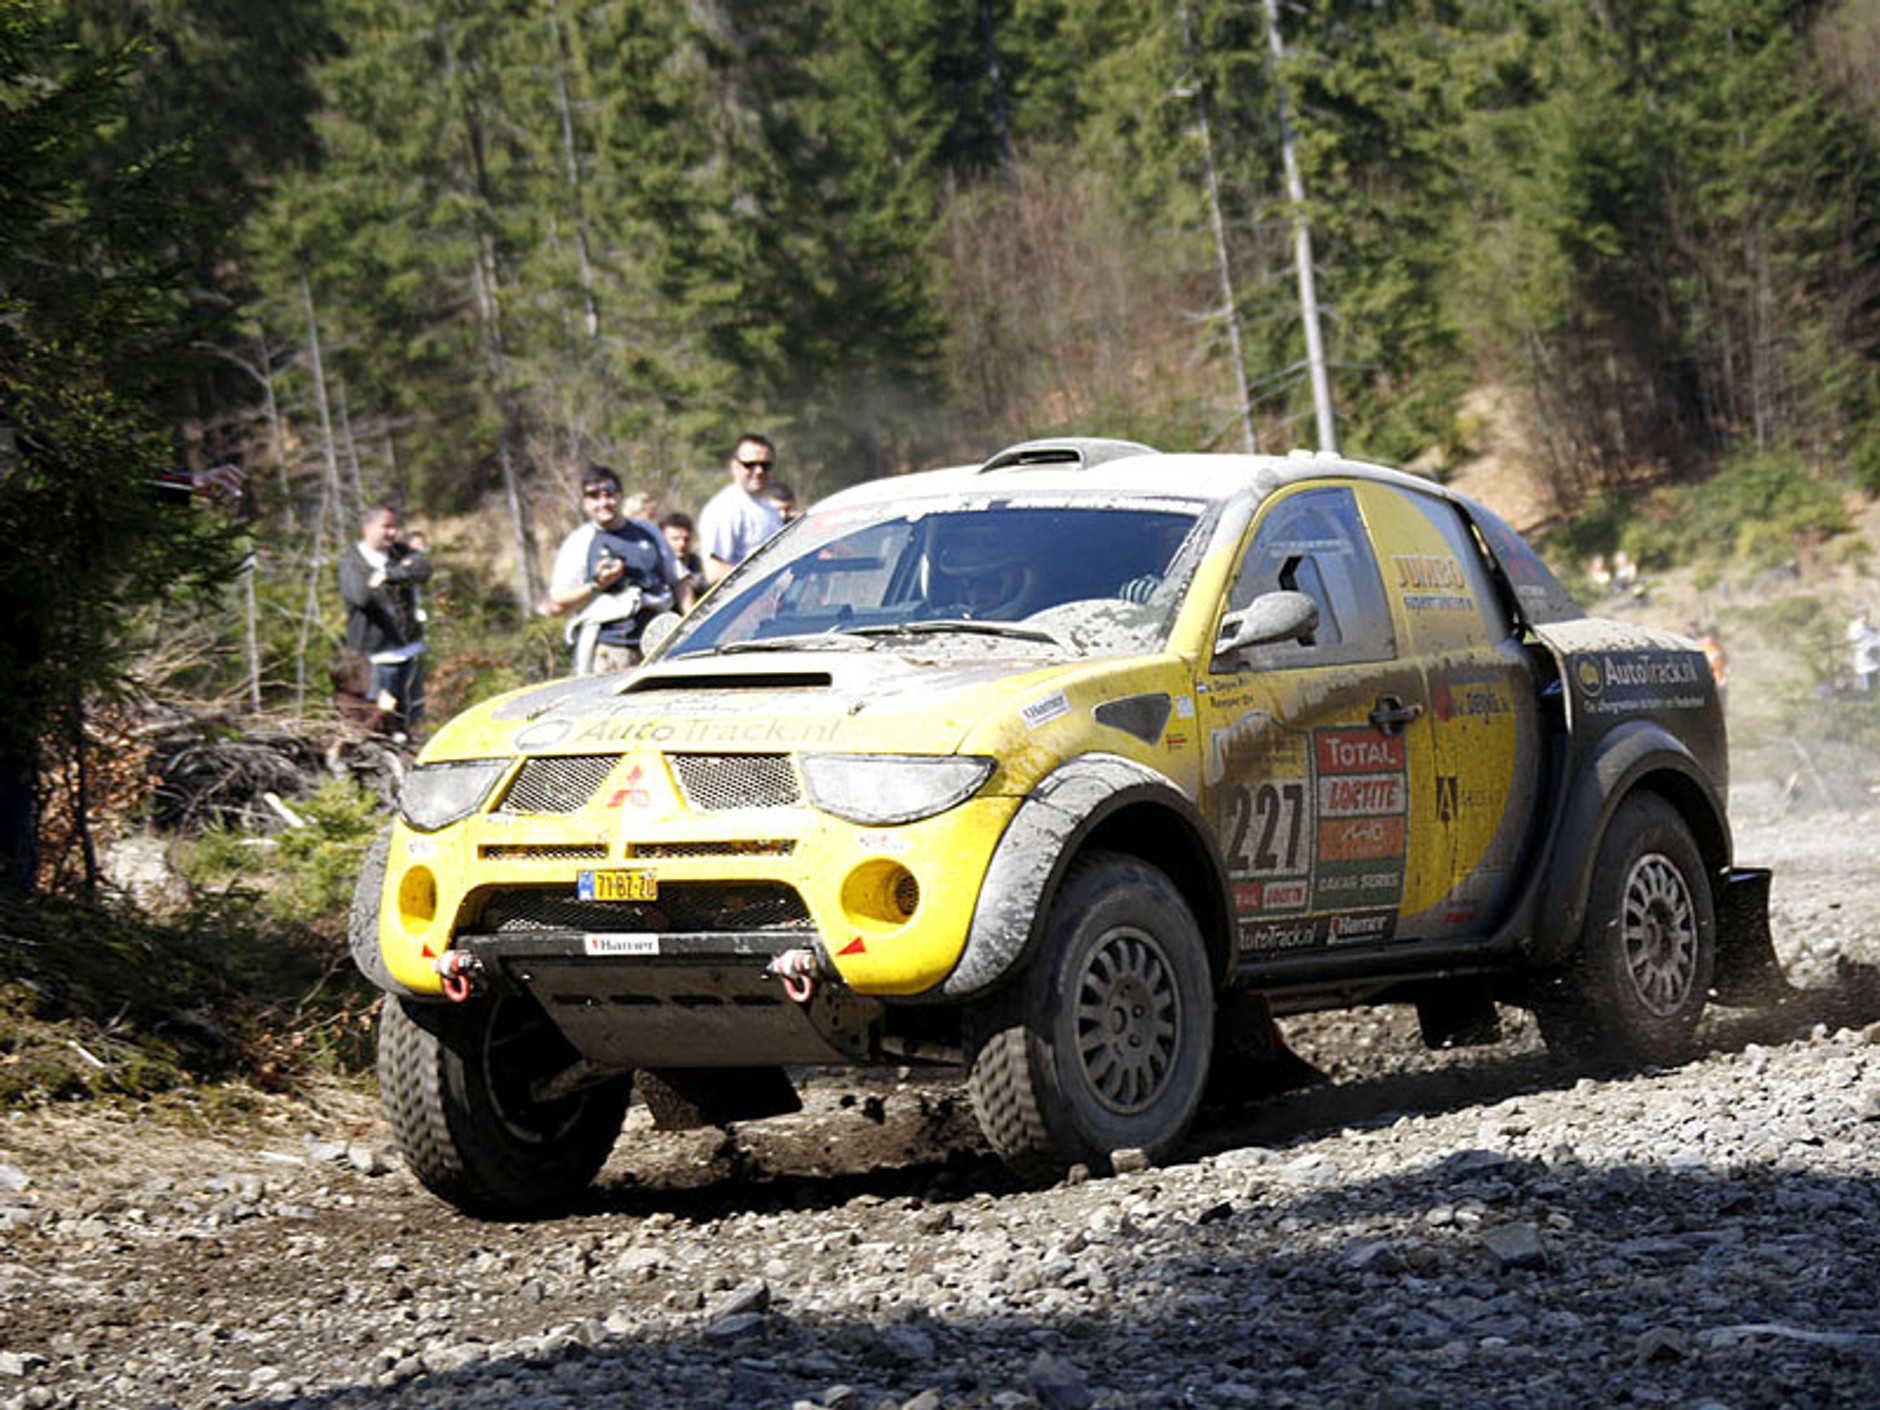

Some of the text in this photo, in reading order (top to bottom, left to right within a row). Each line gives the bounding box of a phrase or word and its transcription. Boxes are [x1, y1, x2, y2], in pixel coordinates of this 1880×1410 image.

[1605, 655, 1698, 685] AutoTrack.nl
[575, 717, 843, 743] AutoTrack.nl
[1226, 783, 1304, 871] 227
